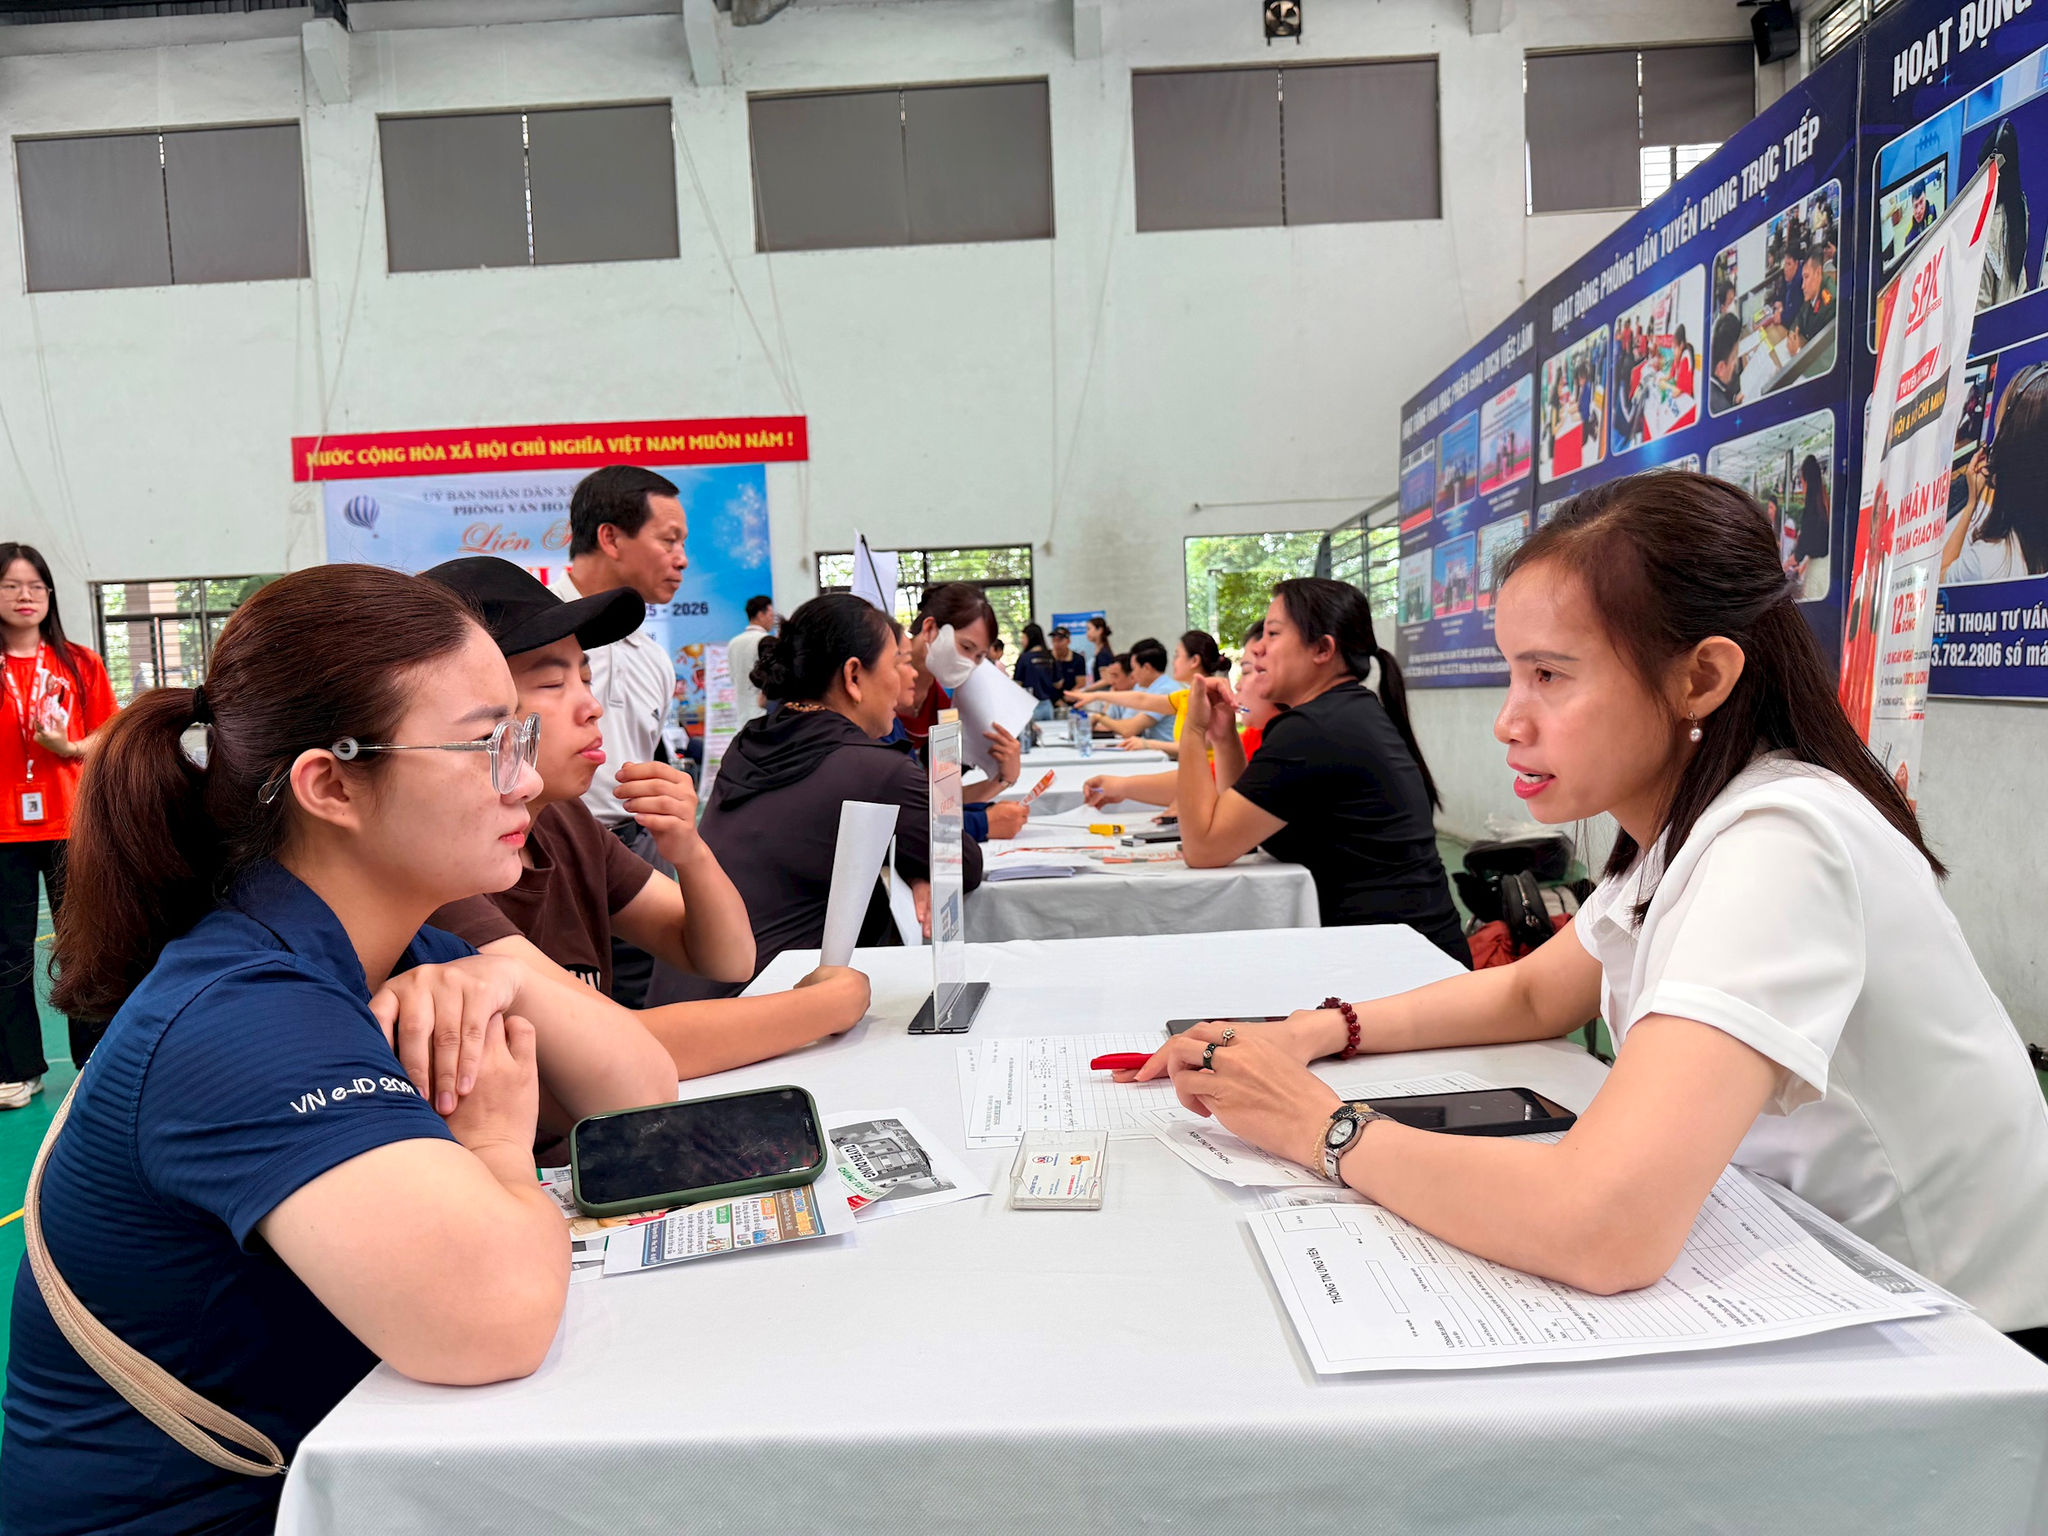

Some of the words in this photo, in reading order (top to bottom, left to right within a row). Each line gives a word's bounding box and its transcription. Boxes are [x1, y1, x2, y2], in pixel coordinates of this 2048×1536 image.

[1892, 16, 1953, 98] HOẠT
[1552, 294, 1574, 333] HOẠT
[1574, 277, 1600, 320] ĐỘNG
[1635, 227, 1659, 275] VẤN
[1660, 197, 1699, 258] TUYỂN
[1700, 175, 1739, 232] DỤNG
[1741, 144, 1780, 202] TRỰC
[1783, 108, 1820, 173] TIẾP
[357, 445, 406, 468] CỘNG
[409, 442, 447, 462] HÒA
[449, 441, 473, 459] XÃ
[476, 439, 508, 461] HỘI
[511, 436, 547, 457] CHỦ
[550, 435, 604, 455] NGHĨA
[606, 434, 643, 455] VIỆT
[646, 434, 685, 452] NAM
[689, 431, 741, 450] MUÔN
[787, 431, 794, 447] !
[1897, 480, 1931, 529] NHÂN
[1932, 464, 1951, 512] VIÊ
[1912, 522, 1932, 548] GIAO
[673, 601, 709, 617] 2026
[1959, 611, 1998, 637] THOẠI
[2001, 607, 2021, 631] TƯ
[2005, 637, 2025, 667] số
[290, 1088, 326, 1113] VN
[331, 1077, 376, 1101] e-ID
[1306, 1247, 1321, 1260] VIÊN
[1313, 1259, 1328, 1273] ỨNG
[1320, 1273, 1333, 1283] TIN
[1325, 1283, 1344, 1304] THÔNG
